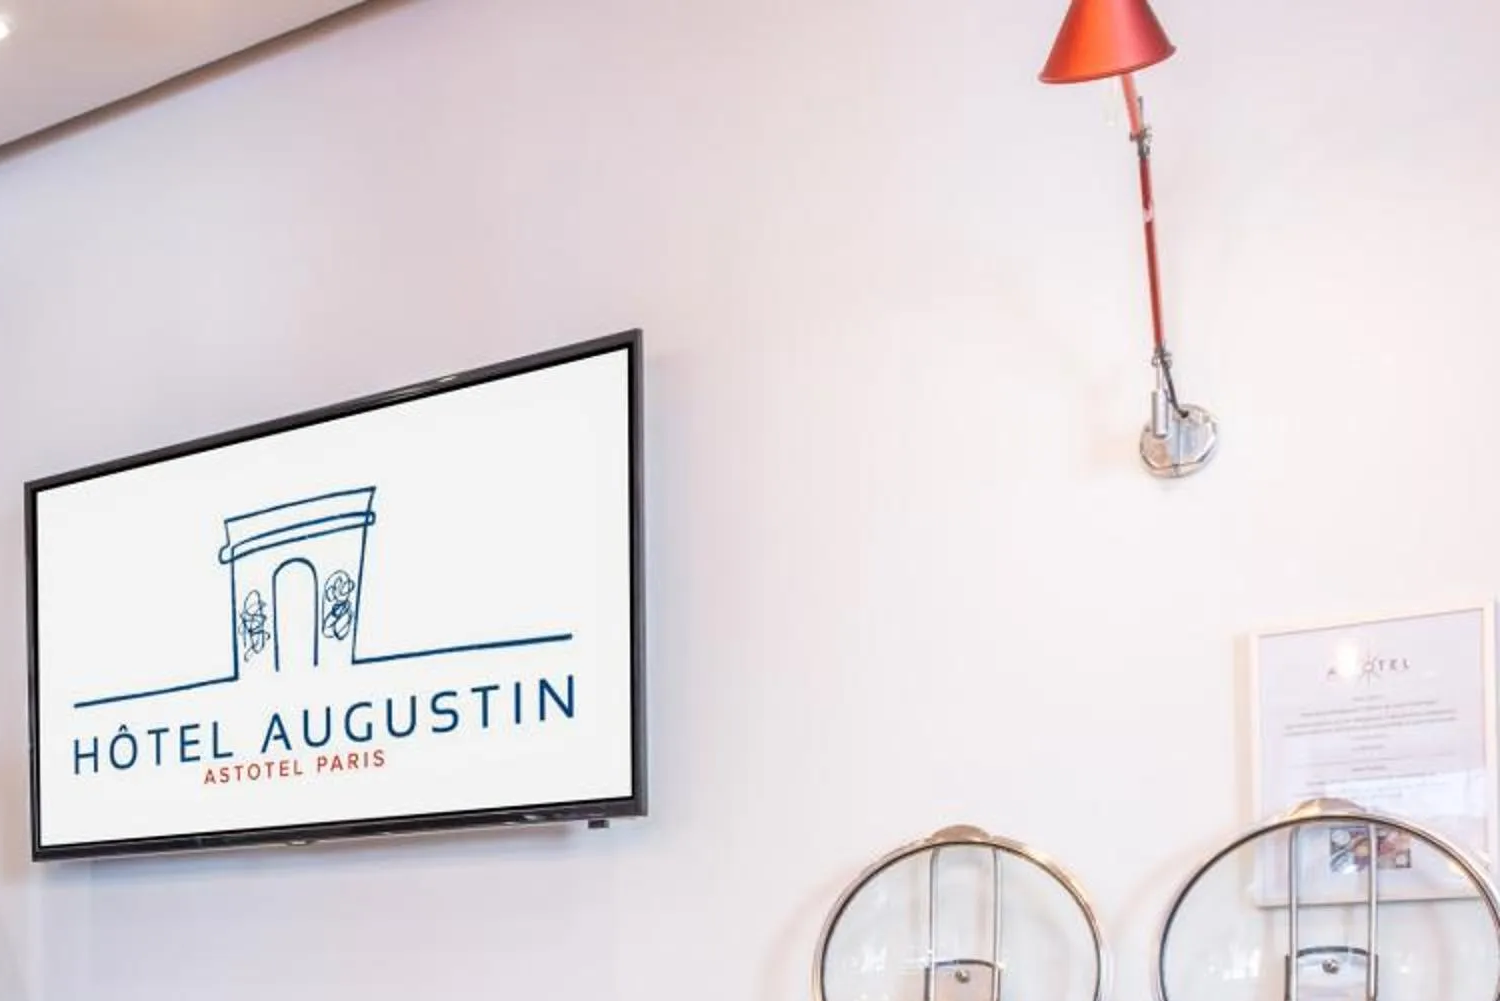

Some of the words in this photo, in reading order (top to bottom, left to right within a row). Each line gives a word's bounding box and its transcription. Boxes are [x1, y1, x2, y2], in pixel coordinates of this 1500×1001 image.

[73, 721, 233, 774] HÔTEL
[260, 674, 575, 754] AUGUSTIN
[203, 758, 304, 785] ASTOTEL
[316, 749, 386, 773] PARIS
